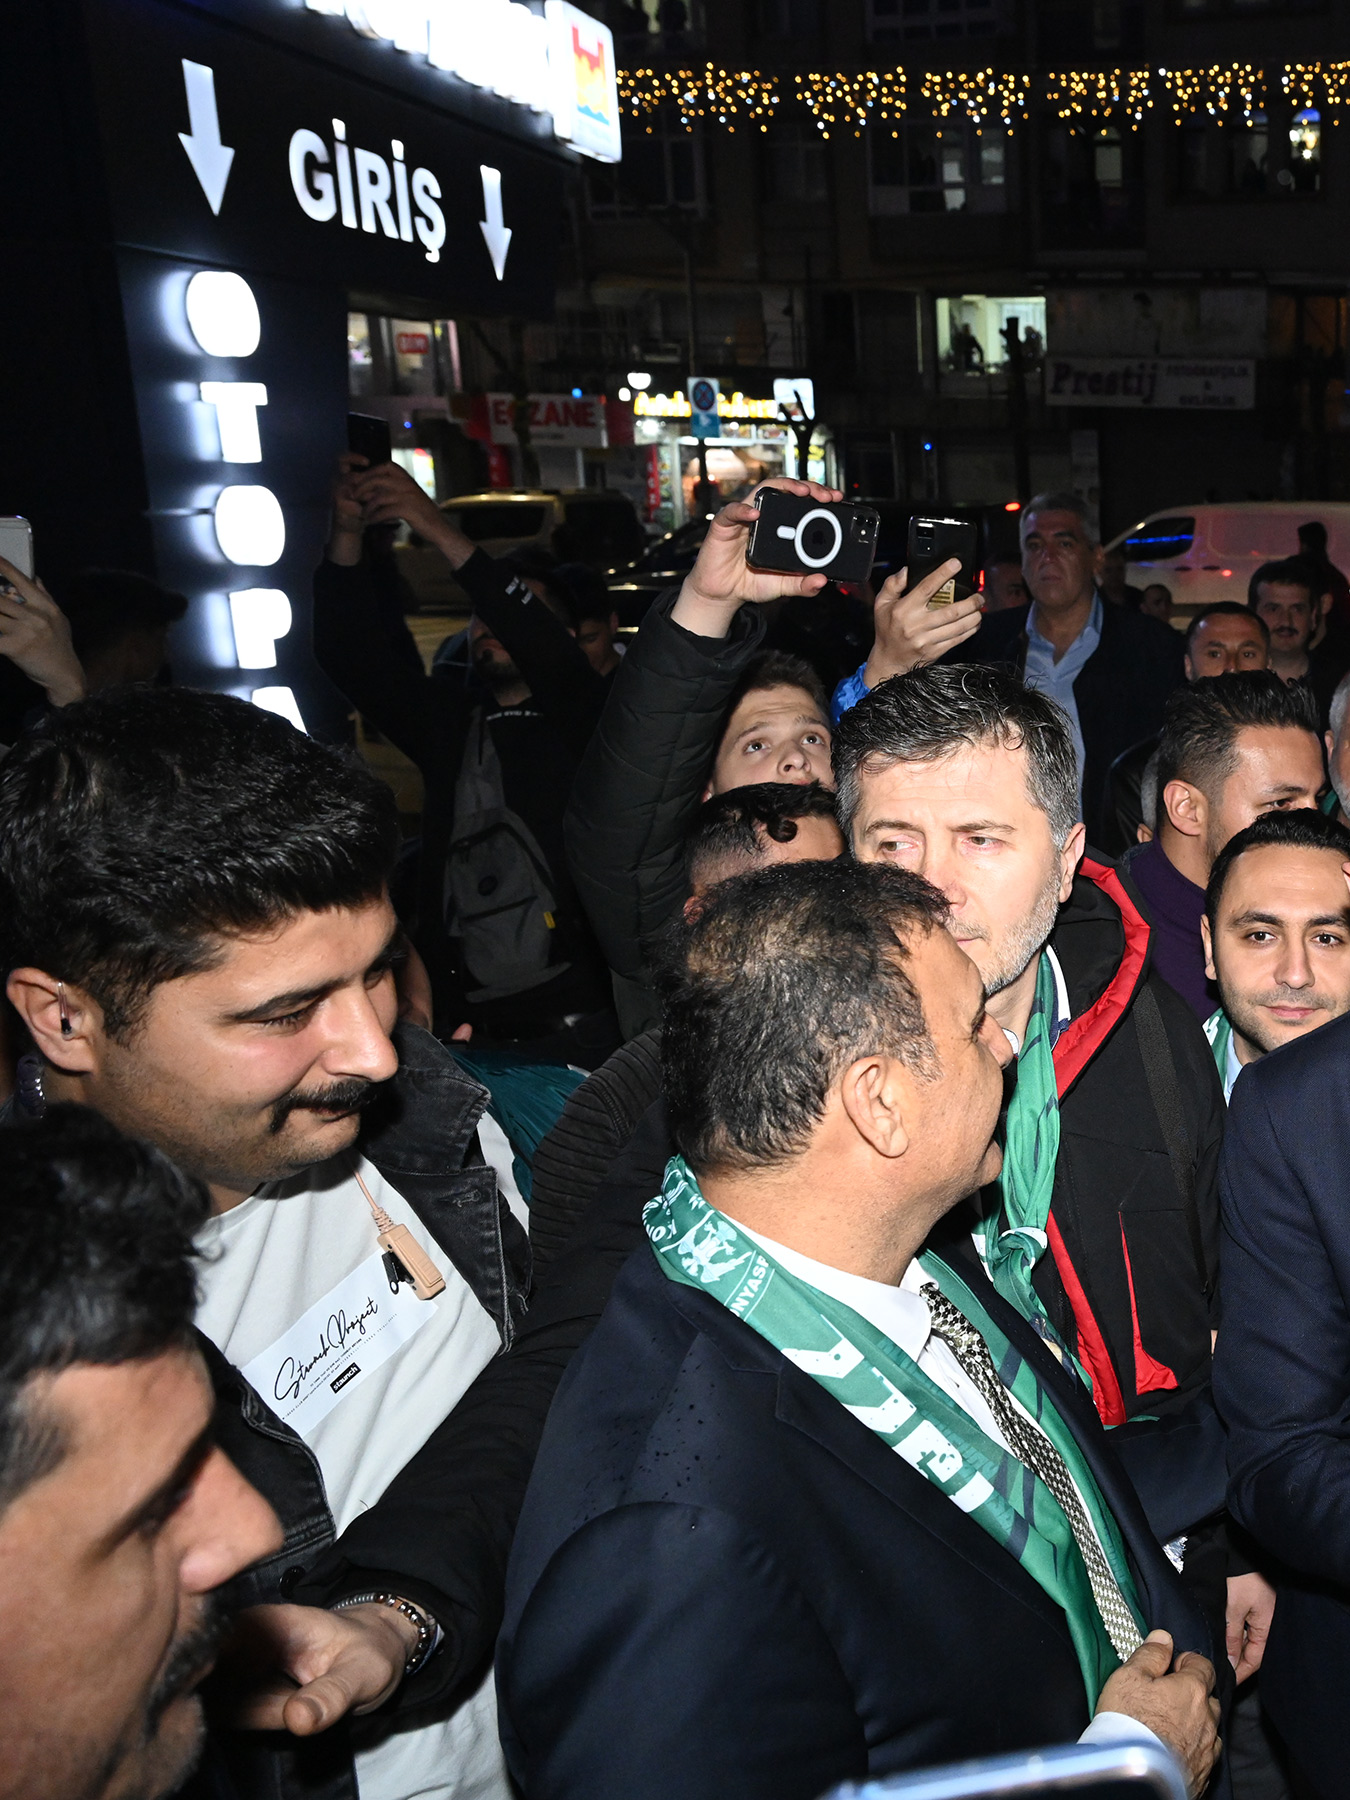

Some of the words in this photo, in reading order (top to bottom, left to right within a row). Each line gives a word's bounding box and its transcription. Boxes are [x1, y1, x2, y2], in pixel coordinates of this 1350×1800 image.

[288, 118, 446, 262] GİRİŞ
[1049, 362, 1158, 404] Prestij
[326, 1296, 379, 1350] Project
[332, 1364, 360, 1391] staunch
